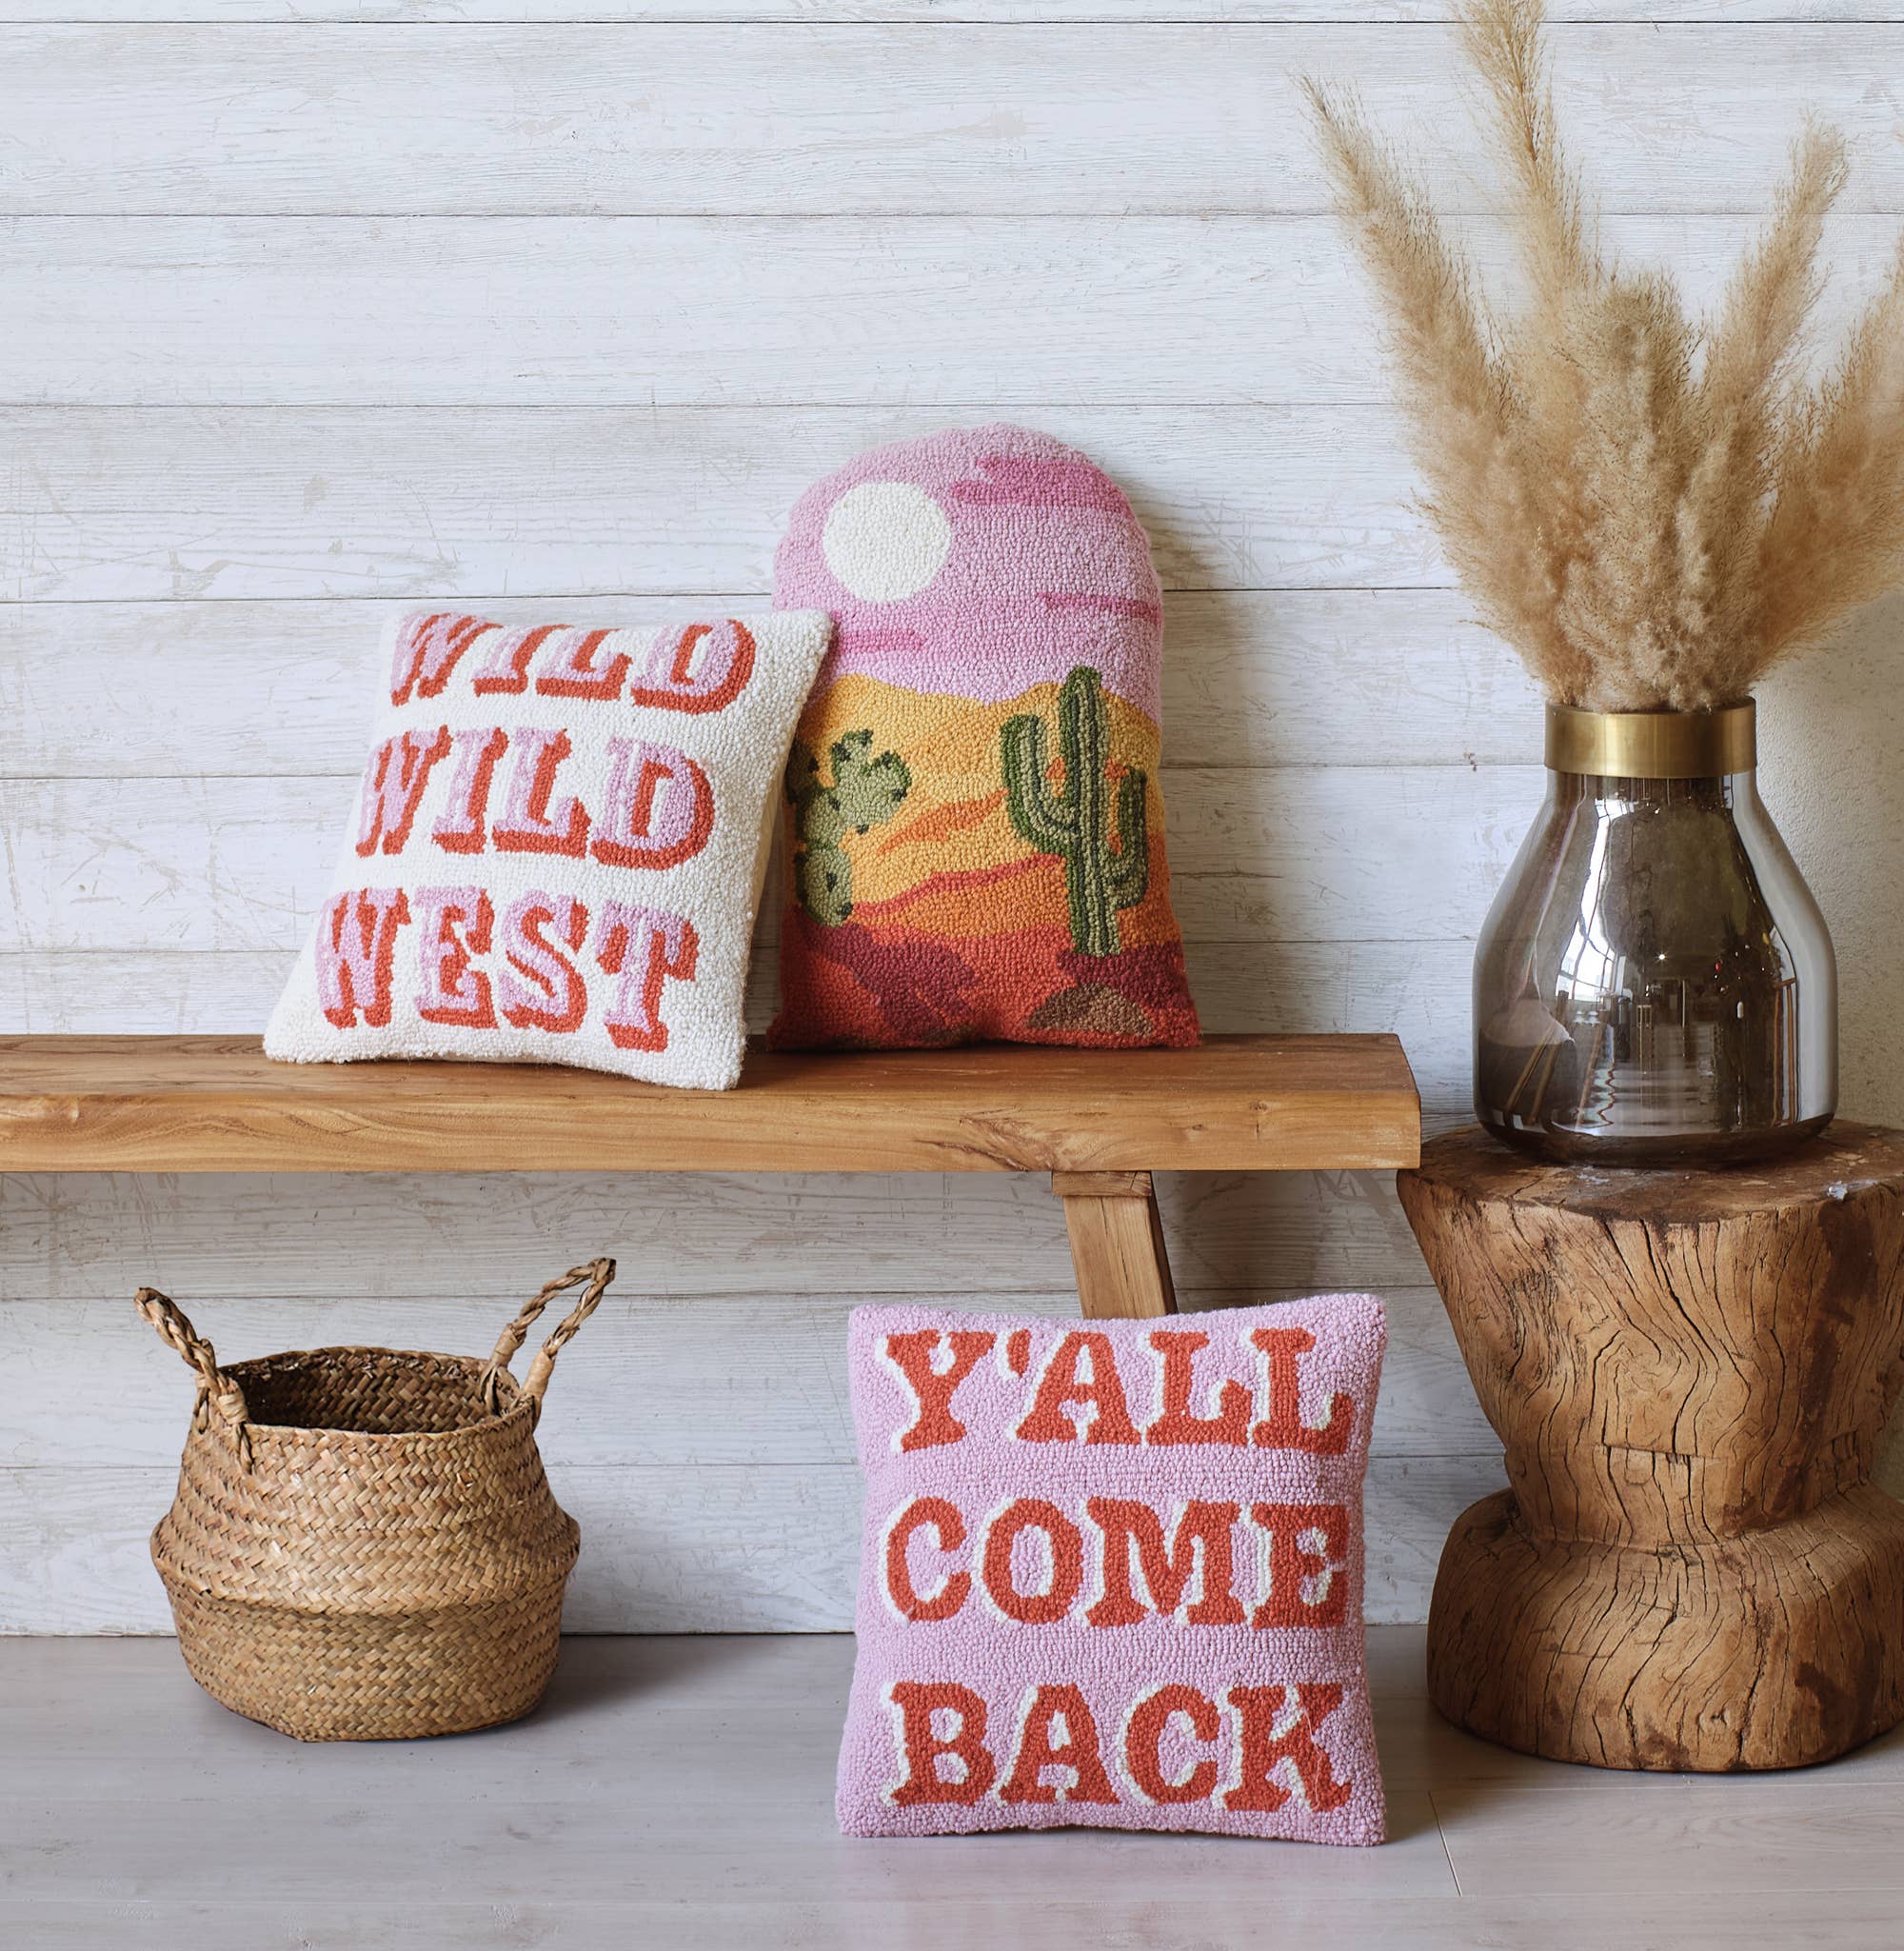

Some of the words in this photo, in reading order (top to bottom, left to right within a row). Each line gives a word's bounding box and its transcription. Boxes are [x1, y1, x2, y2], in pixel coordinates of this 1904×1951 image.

[390, 612, 756, 714] WILD
[356, 725, 715, 870] WILD
[315, 886, 699, 1052] WEST
[877, 1328, 1354, 1454] Y'ALL
[879, 1495, 1350, 1630] COME
[880, 1681, 1353, 1812] BACK
